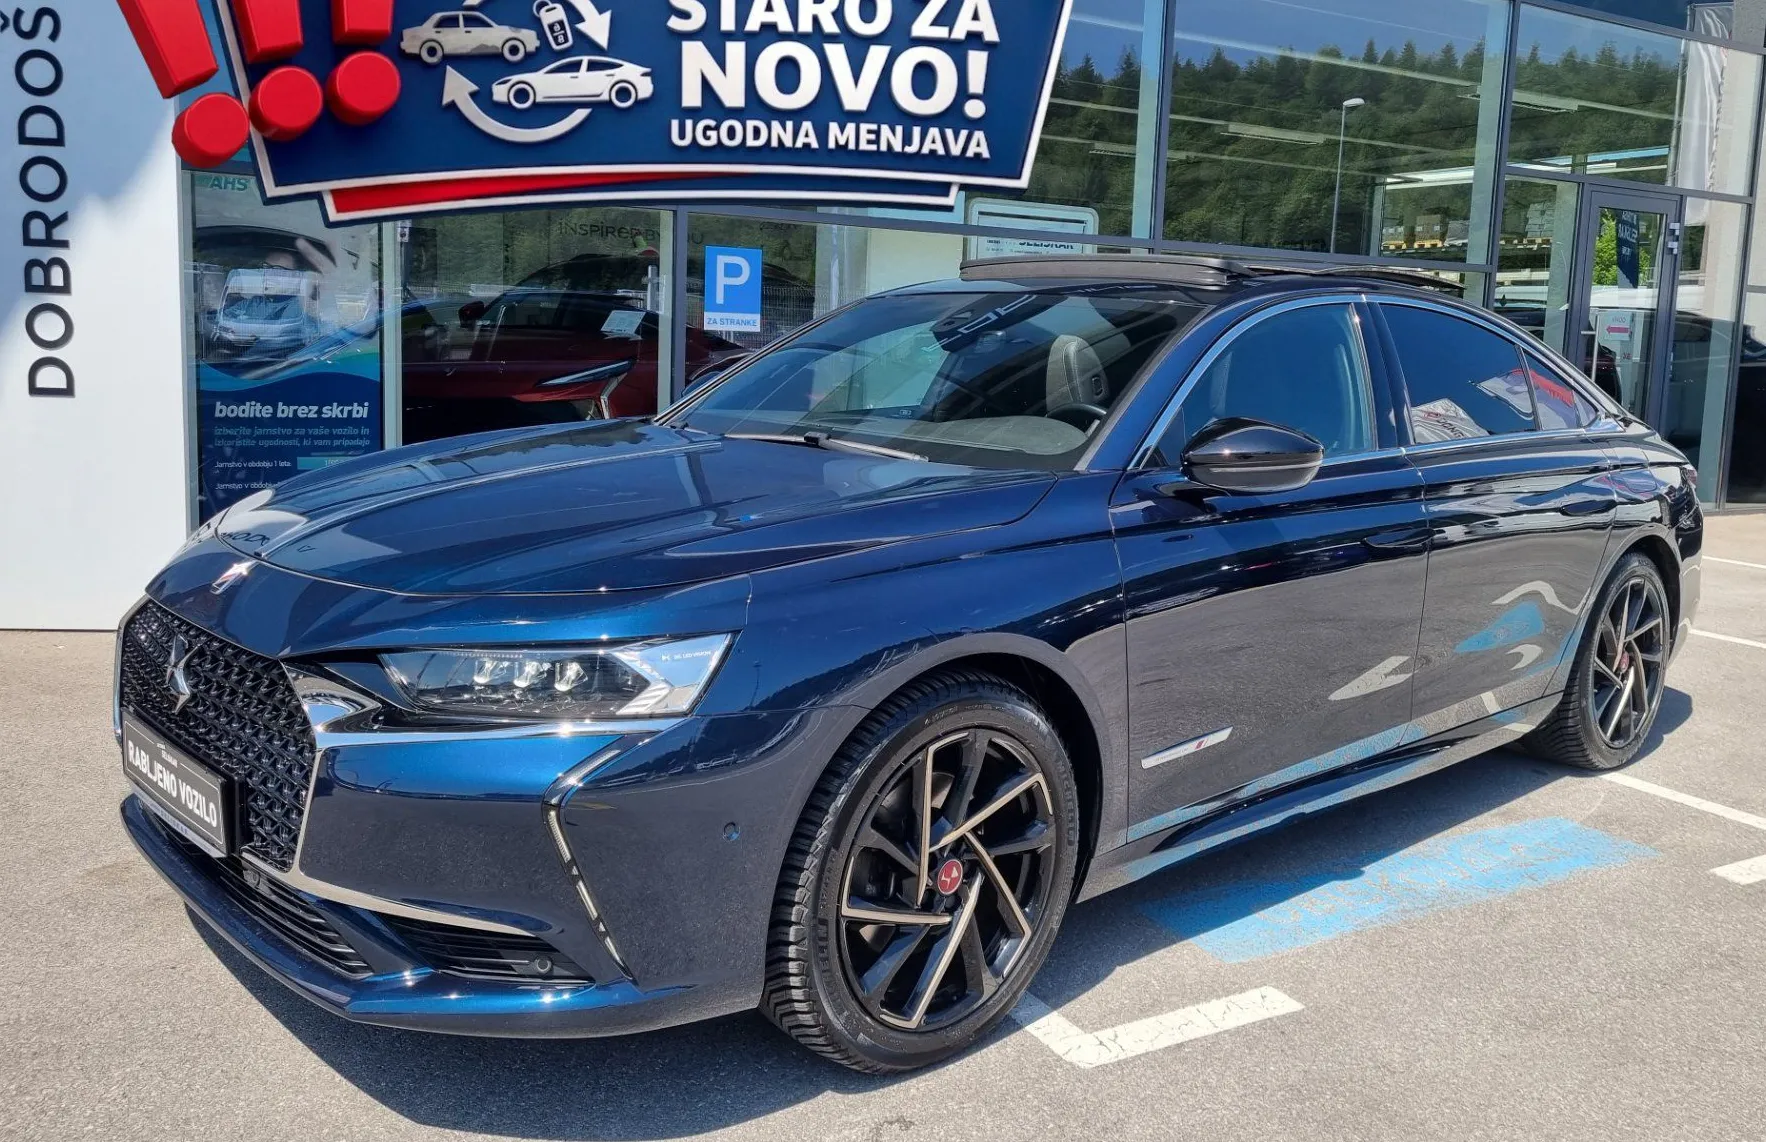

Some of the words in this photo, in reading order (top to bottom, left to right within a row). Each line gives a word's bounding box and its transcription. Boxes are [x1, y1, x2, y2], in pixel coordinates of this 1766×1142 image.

[715, 254, 751, 305] P
[706, 317, 718, 325] ZA
[720, 317, 758, 327] STRANKE
[214, 401, 274, 418] bodite
[277, 402, 318, 418] brez
[321, 402, 369, 418] skrbi
[252, 427, 291, 438] jamstvo
[294, 428, 305, 436] za
[307, 426, 329, 436] vaše
[332, 427, 358, 436] vozilo
[360, 426, 370, 436] in
[314, 439, 331, 447] vam
[333, 438, 371, 448] pripadajo
[127, 740, 178, 798] RABLJENO
[178, 779, 217, 828] VOZILO
